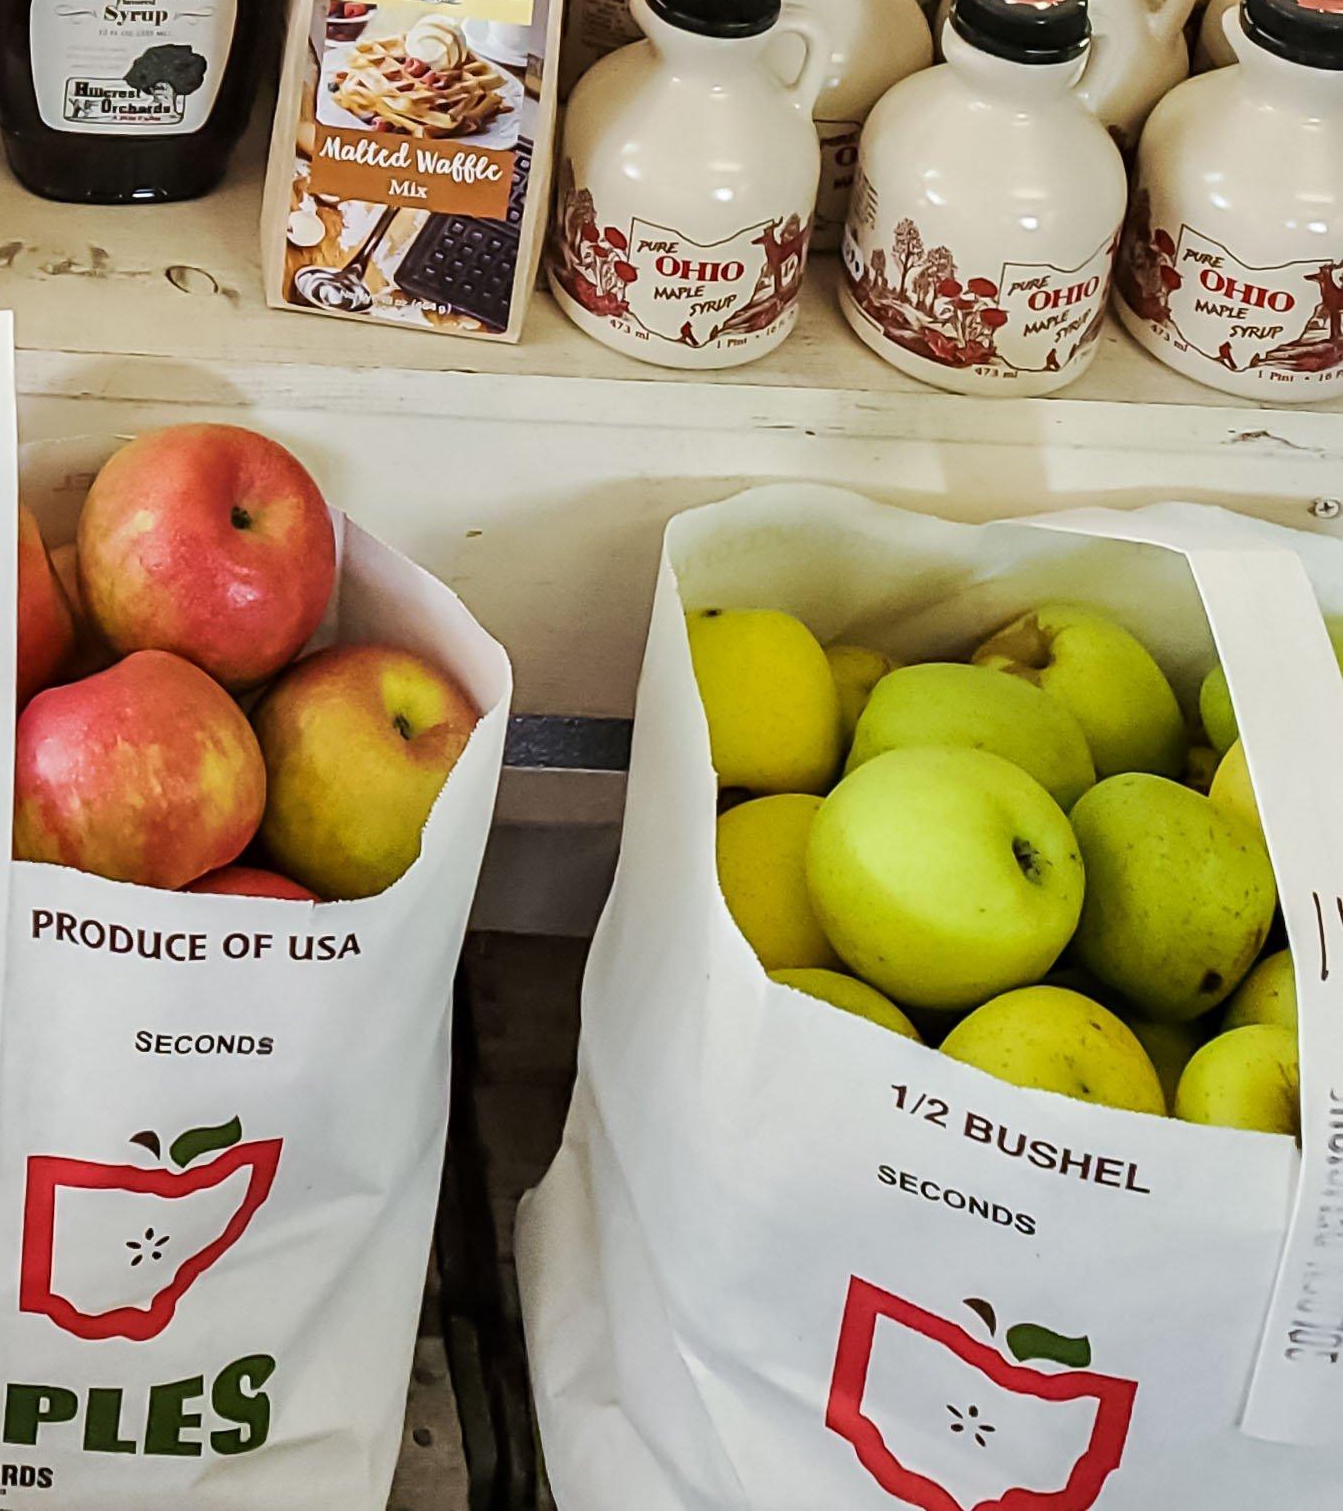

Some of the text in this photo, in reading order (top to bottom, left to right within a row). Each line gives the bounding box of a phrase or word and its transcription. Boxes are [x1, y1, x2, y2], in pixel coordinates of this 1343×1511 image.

[103, 5, 168, 26] Syrup
[319, 135, 503, 184] Malted Waffle
[388, 179, 428, 200] Mix
[637, 240, 679, 254] PURE
[1183, 248, 1225, 268] PURE
[655, 256, 744, 282] OHIO
[654, 286, 705, 300] MAPLE
[1008, 276, 1051, 296] PURE
[1028, 276, 1100, 311] OHIO
[1200, 269, 1295, 313] OHIO
[689, 295, 737, 317] SYRUP
[1195, 299, 1249, 319] MAPLE
[1024, 309, 1070, 337] MAPLE
[1229, 325, 1284, 339] SYRUP
[30, 907, 362, 963] PRODUCE OF USA
[134, 1030, 275, 1057] SECONDS
[890, 1084, 1150, 1194] 1/2 BUSHEL
[877, 1163, 1036, 1236] SECONDS
